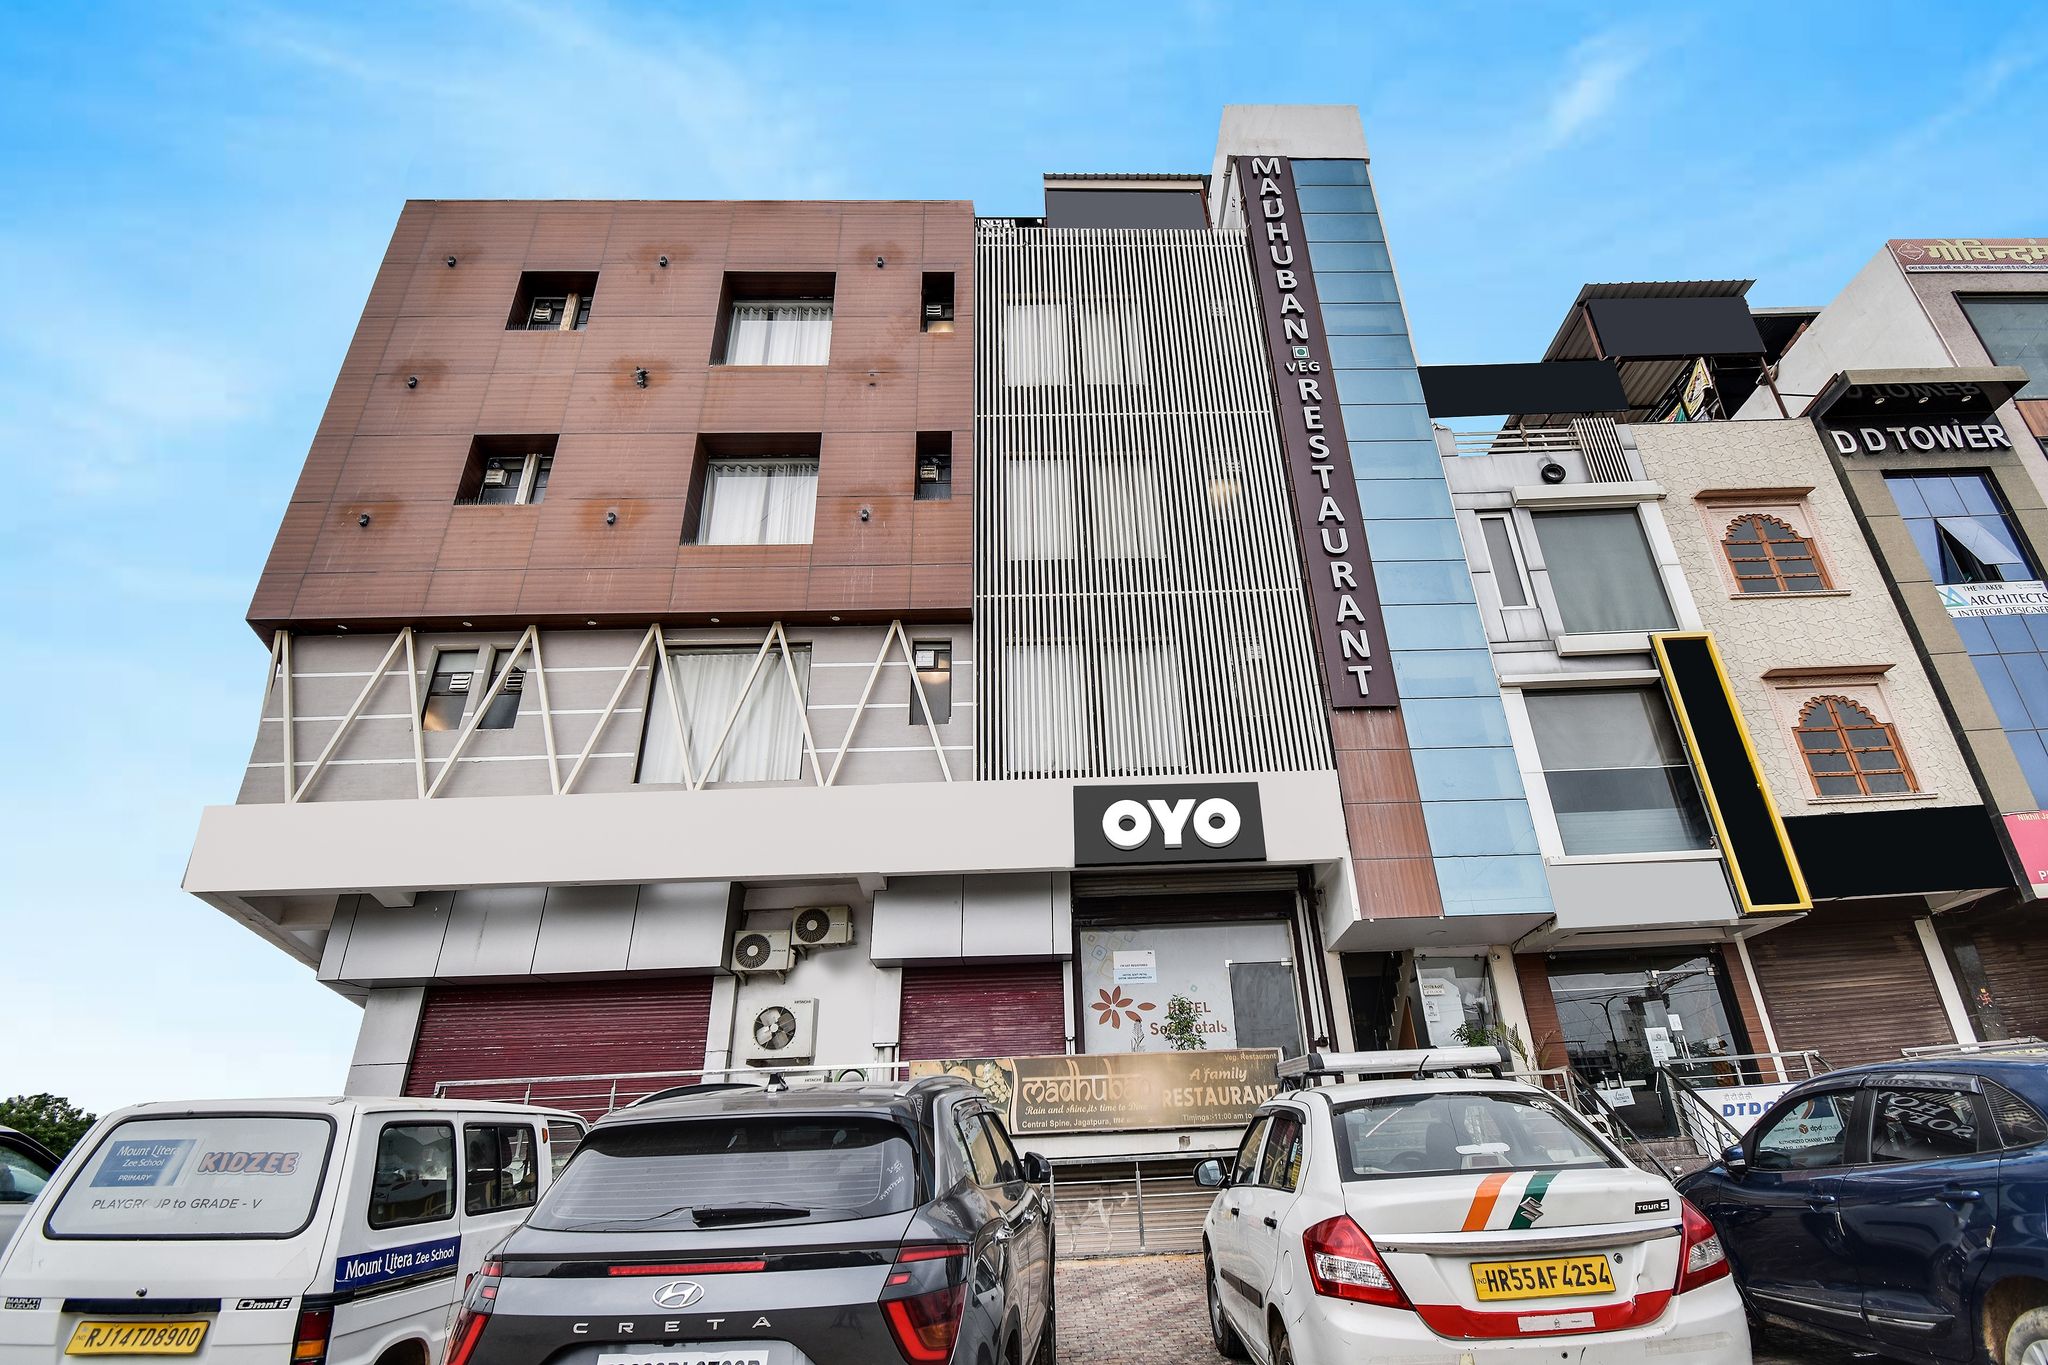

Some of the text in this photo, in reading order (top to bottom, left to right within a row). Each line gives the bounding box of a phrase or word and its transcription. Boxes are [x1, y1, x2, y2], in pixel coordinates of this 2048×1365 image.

[1252, 157, 1309, 340] MADHUBAN
[1285, 361, 1320, 373] VEG
[1830, 424, 2012, 454] D D TOWER
[1298, 378, 1372, 695] RESTAURANT
[1970, 592, 2048, 606] ARCHITECTS
[1958, 607, 2004, 617] INTERIOR
[2005, 606, 2048, 615] DESIGNE
[2017, 813, 2040, 821] Nikhil
[1102, 798, 1241, 850] OYO
[2038, 870, 2048, 881] P
[1168, 1001, 1211, 1014] HEL
[1187, 1020, 1228, 1034] etals
[1224, 1052, 1277, 1061] Veg. Restaurant
[1189, 1066, 1247, 1083] A family
[1162, 1084, 1278, 1108] RESTAURANT
[1024, 1105, 1046, 1115] Rain
[1047, 1105, 1064, 1114] and
[1100, 1103, 1117, 1112] time
[1021, 1120, 1048, 1129] Central
[1049, 1119, 1071, 1129] Spine,
[116, 1145, 150, 1157] Mount
[122, 1157, 165, 1168] Zee School
[198, 1151, 302, 1176] KIDZEE
[118, 1174, 152, 1182] PRIMARY
[173, 1199, 187, 1209] to
[190, 1198, 240, 1209] GRADE
[252, 1199, 263, 1209] V
[1637, 1201, 1669, 1211] TOUR S
[344, 1245, 455, 1280] Mount Litera Zee School
[573, 1316, 772, 1334] CRETA
[83, 1326, 202, 1349] RJ14TD8900
